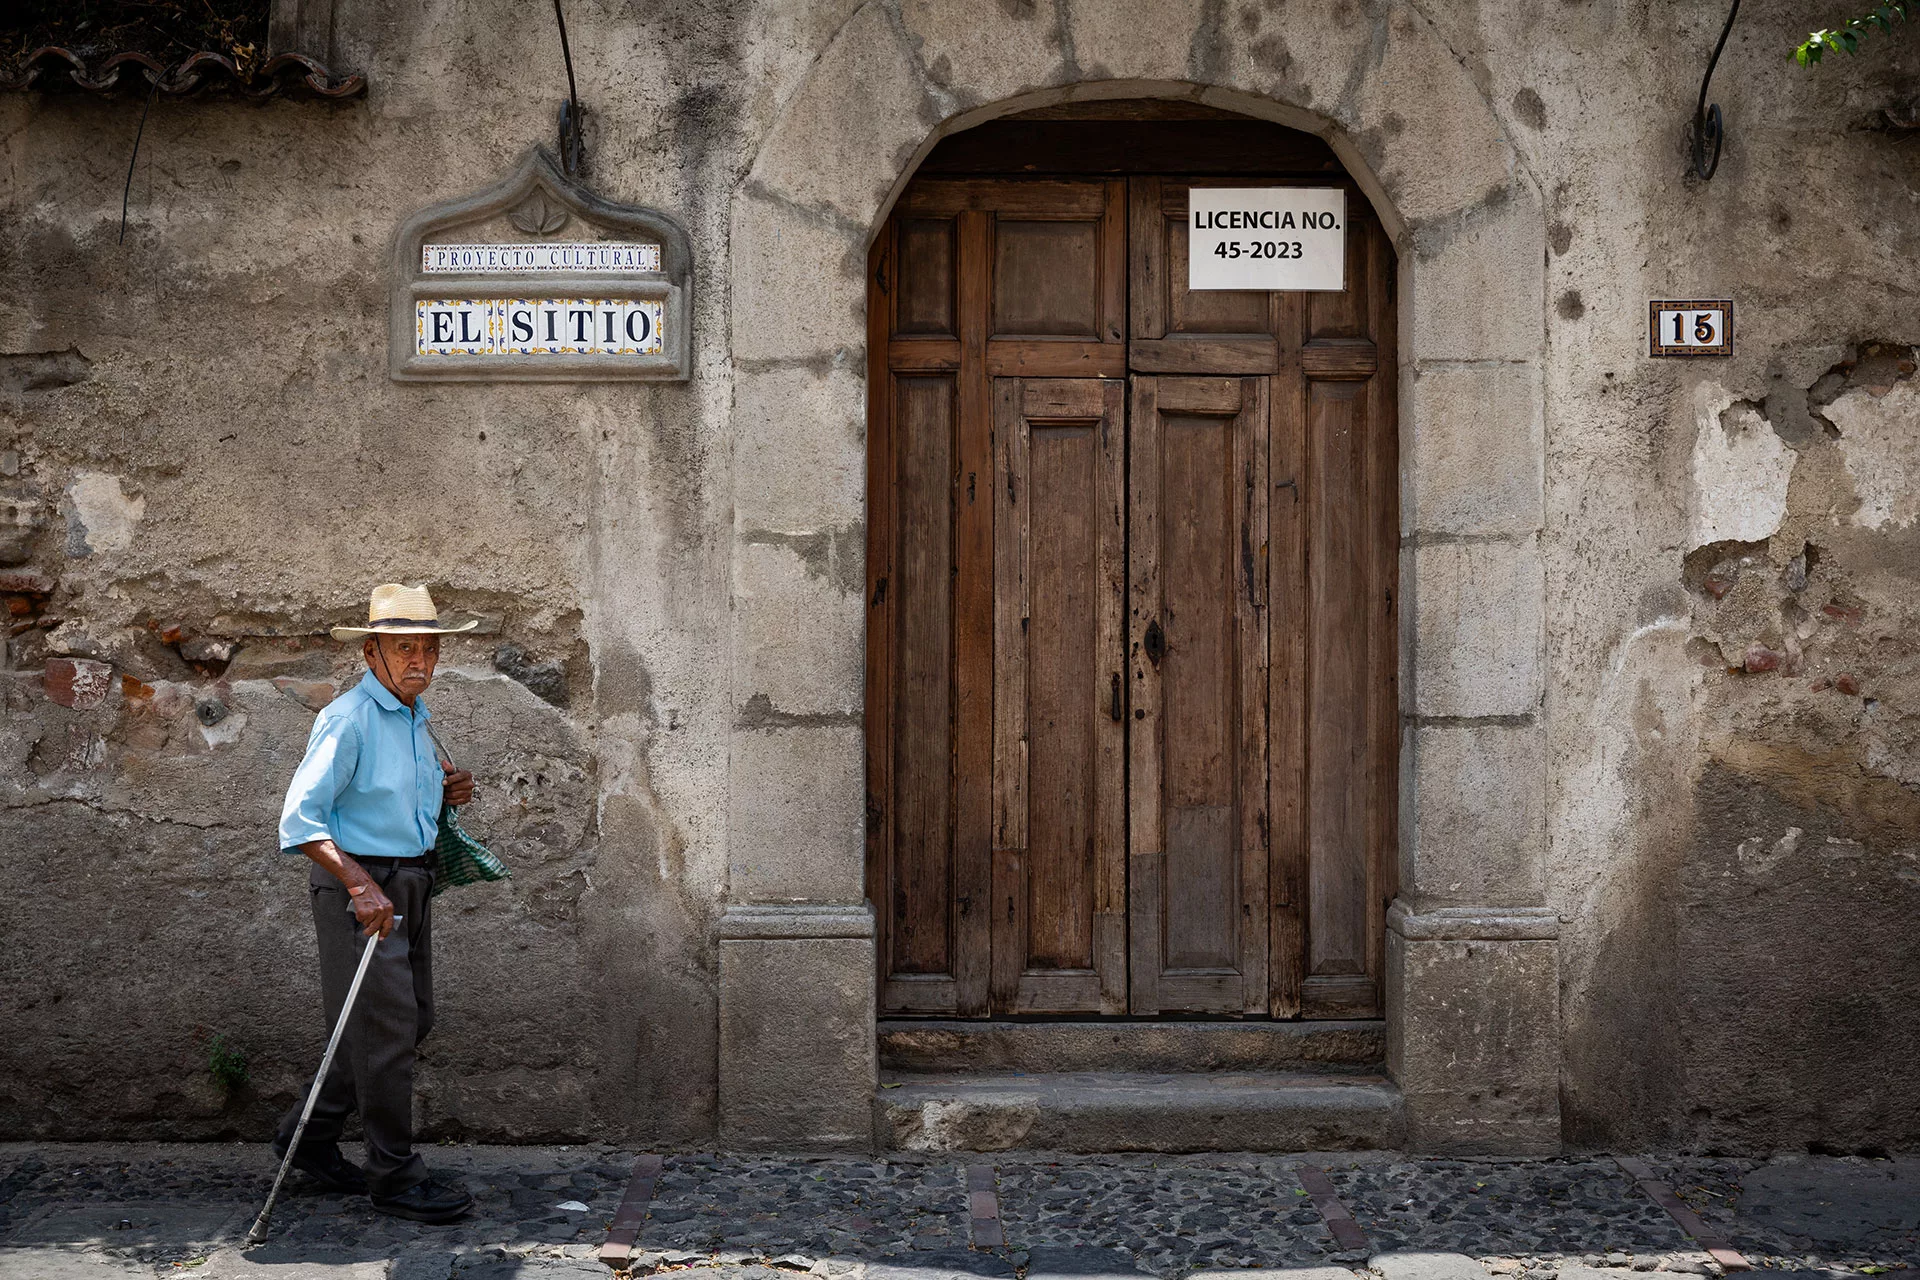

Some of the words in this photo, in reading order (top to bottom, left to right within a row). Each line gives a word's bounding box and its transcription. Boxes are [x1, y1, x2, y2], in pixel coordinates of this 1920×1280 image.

[1195, 211, 1296, 229] LICENCIA
[1302, 211, 1341, 230] NO.
[438, 251, 534, 266] PROYECTO
[550, 250, 645, 266] CULTURAL
[1213, 241, 1303, 259] 45-2023
[431, 311, 481, 343] EL
[512, 310, 650, 343] SITIO
[1672, 313, 1715, 344] 15
